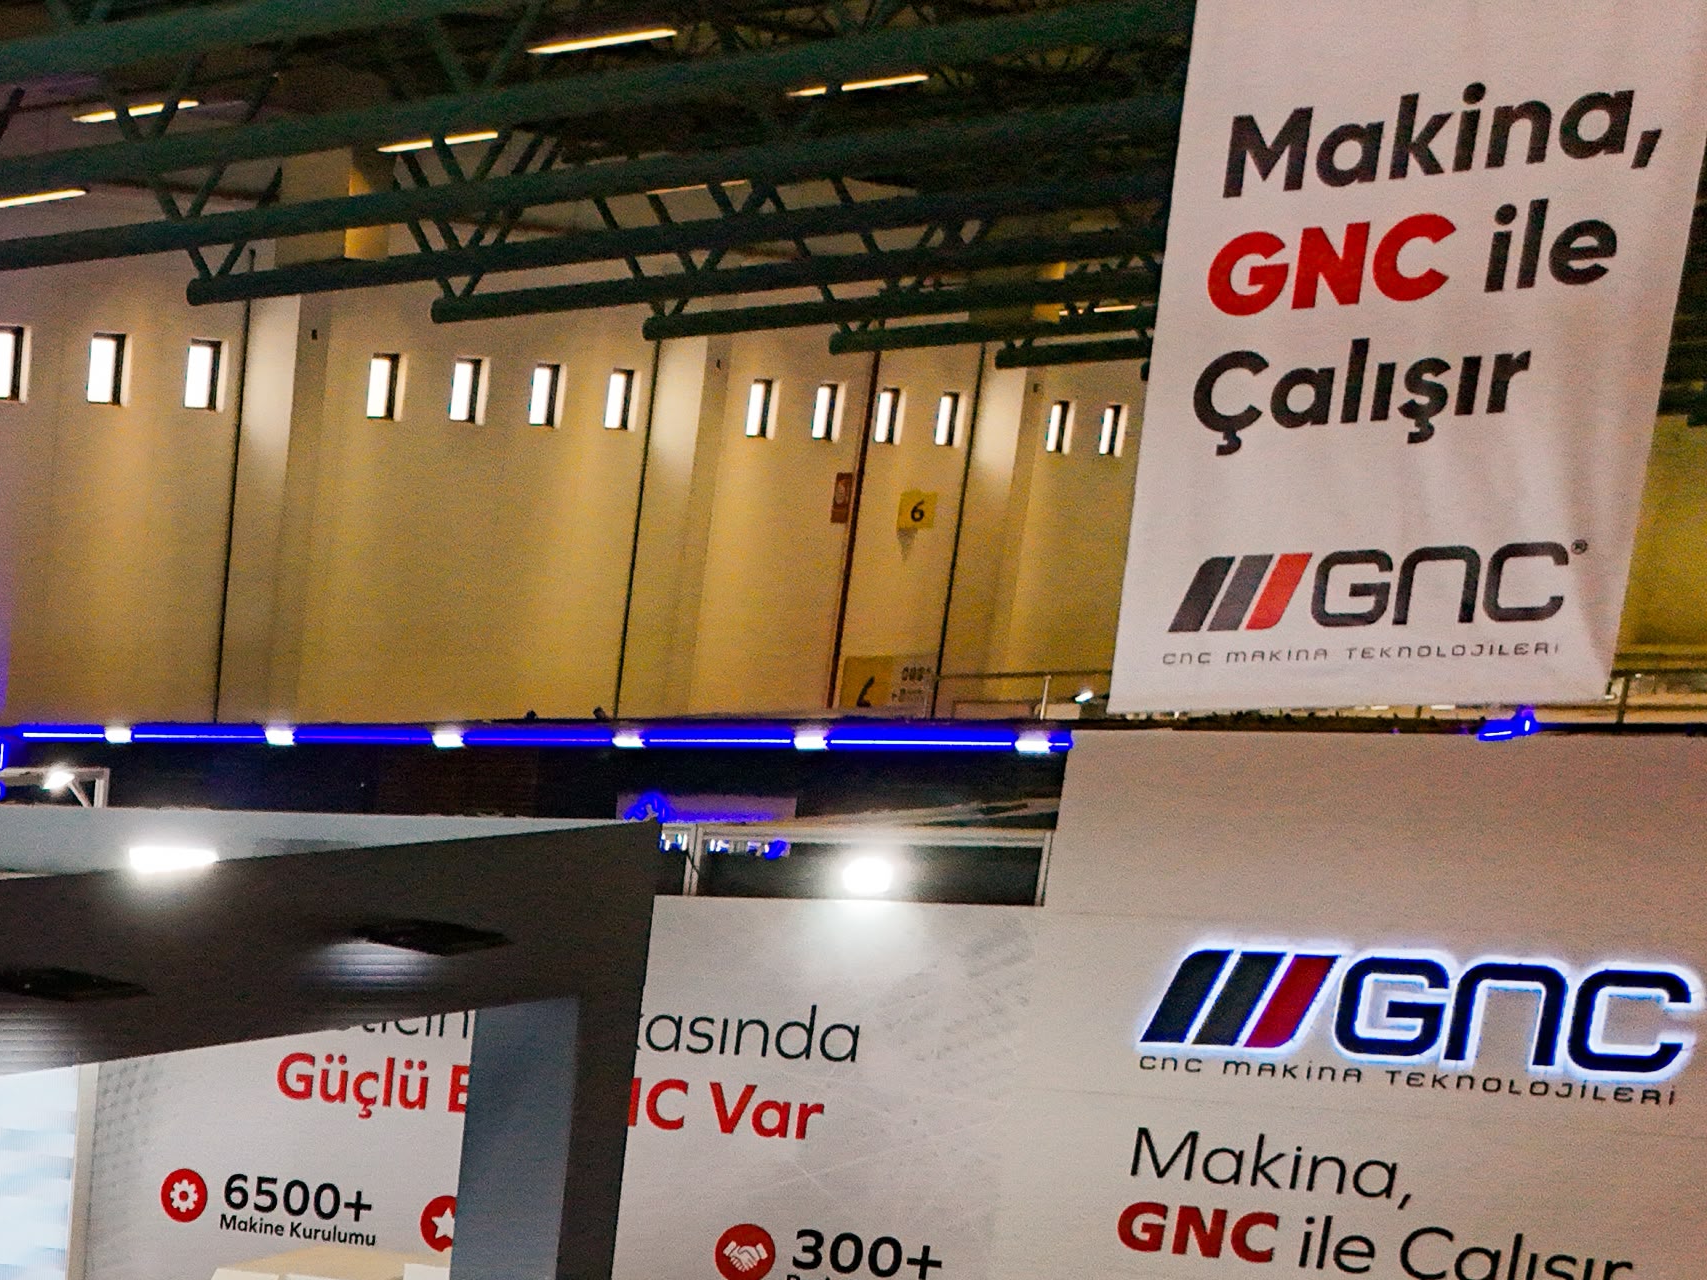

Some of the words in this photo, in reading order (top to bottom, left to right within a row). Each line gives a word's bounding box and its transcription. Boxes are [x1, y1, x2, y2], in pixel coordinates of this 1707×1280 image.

[1223, 82, 1662, 198] Makina,
[1207, 213, 1456, 316] GNC
[1484, 198, 1617, 293] ile
[1193, 337, 1531, 456] Çalışır
[910, 500, 925, 522] 6
[1311, 541, 1570, 627] GNC
[636, 1005, 862, 1063] asında
[1334, 956, 1692, 1073] GNC
[276, 1051, 429, 1120] Güçlü
[709, 1081, 825, 1140] Var
[224, 1173, 372, 1222] 6500+
[1130, 1126, 1412, 1210] Makina,
[220, 1214, 284, 1236] Makine
[289, 1222, 376, 1246] Kurulumu
[792, 1229, 942, 1280] 300+
[1116, 1201, 1279, 1263] GNC
[1297, 1214, 1377, 1274] ile
